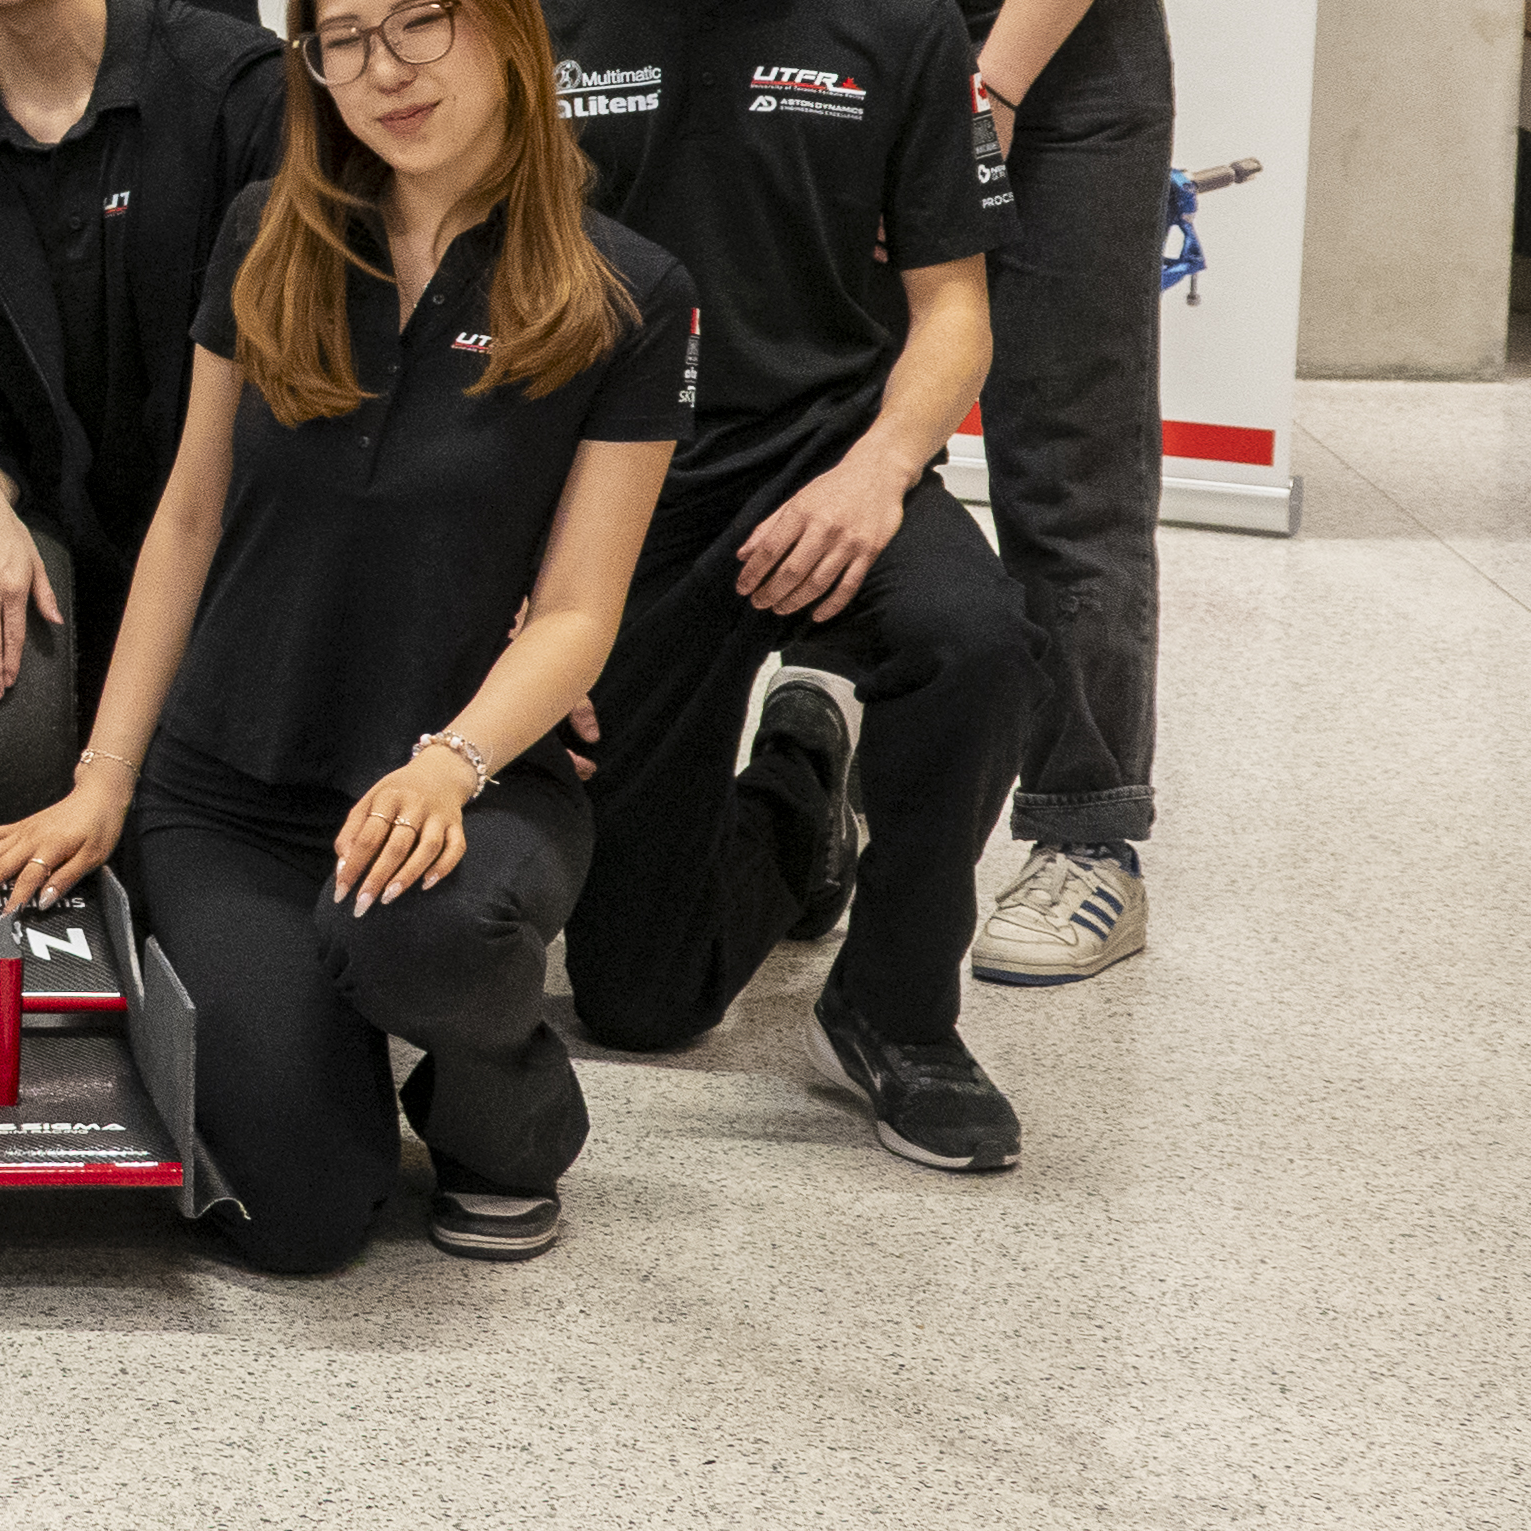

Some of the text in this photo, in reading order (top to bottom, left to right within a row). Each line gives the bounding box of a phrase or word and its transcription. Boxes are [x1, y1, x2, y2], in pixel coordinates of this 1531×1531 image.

[582, 64, 662, 87] Multimatic
[752, 65, 839, 88] UTFR
[573, 92, 660, 118] Litens
